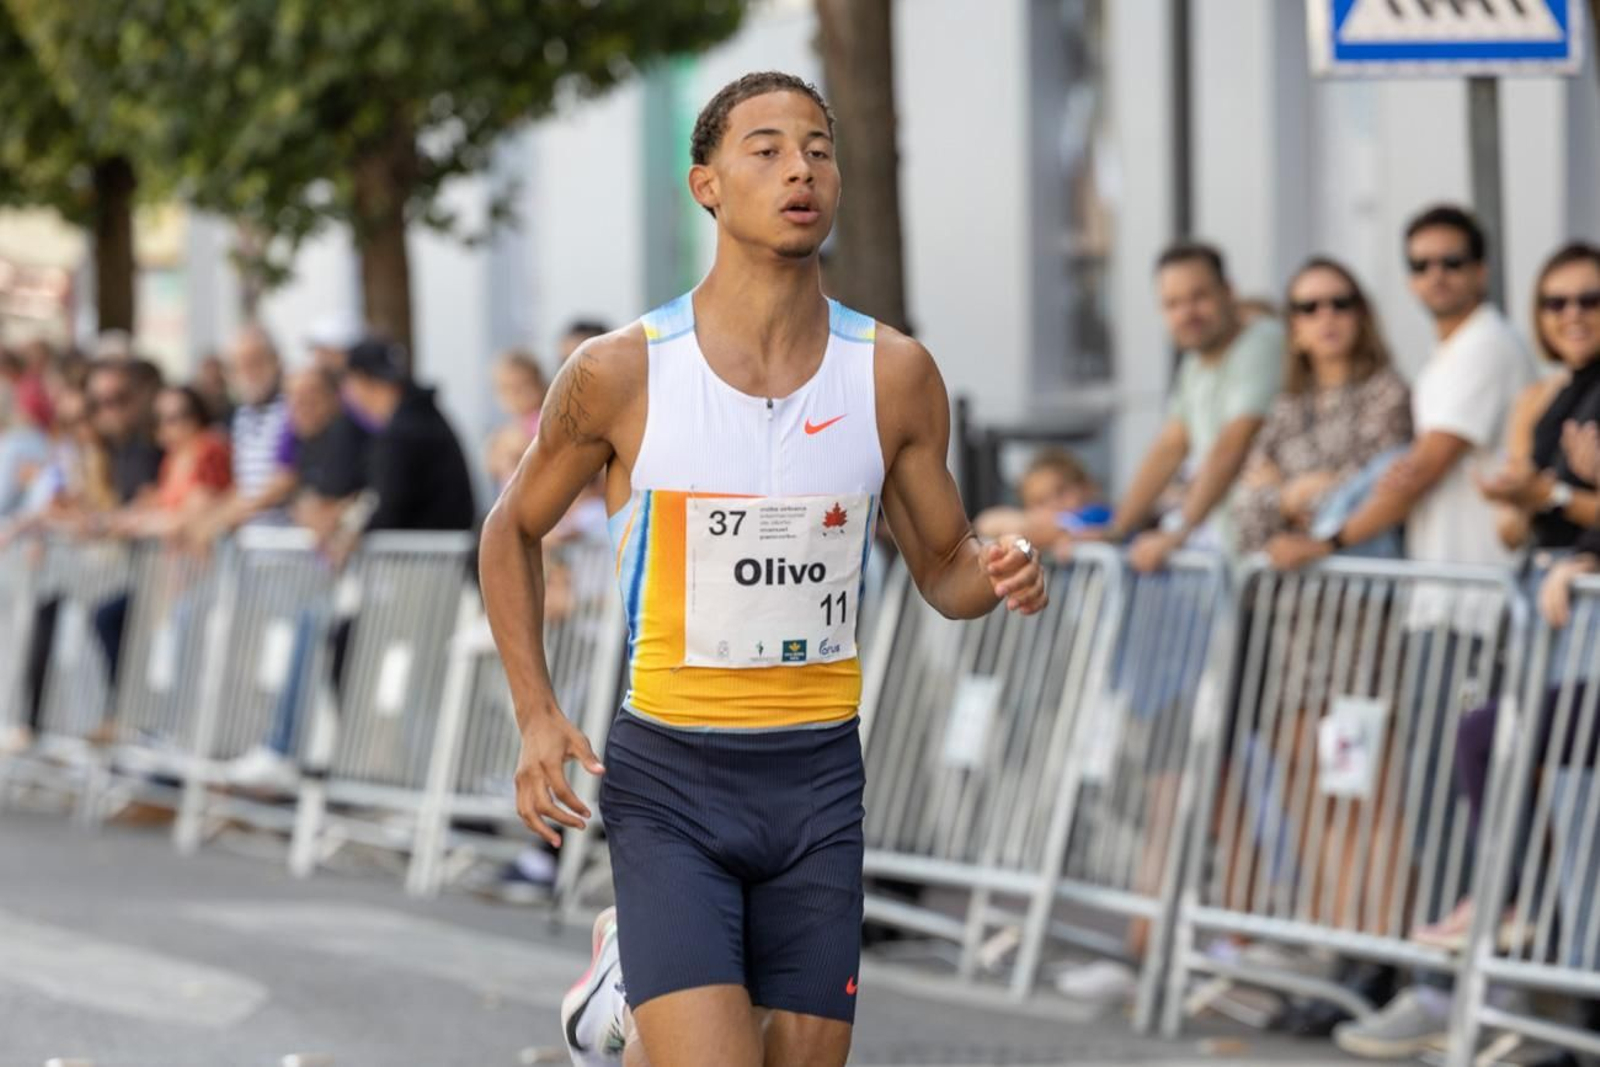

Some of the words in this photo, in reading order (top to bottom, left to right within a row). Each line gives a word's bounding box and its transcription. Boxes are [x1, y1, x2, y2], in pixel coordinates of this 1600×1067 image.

[709, 510, 746, 536] 37
[734, 558, 826, 586] Olivo
[820, 591, 846, 625] 11
